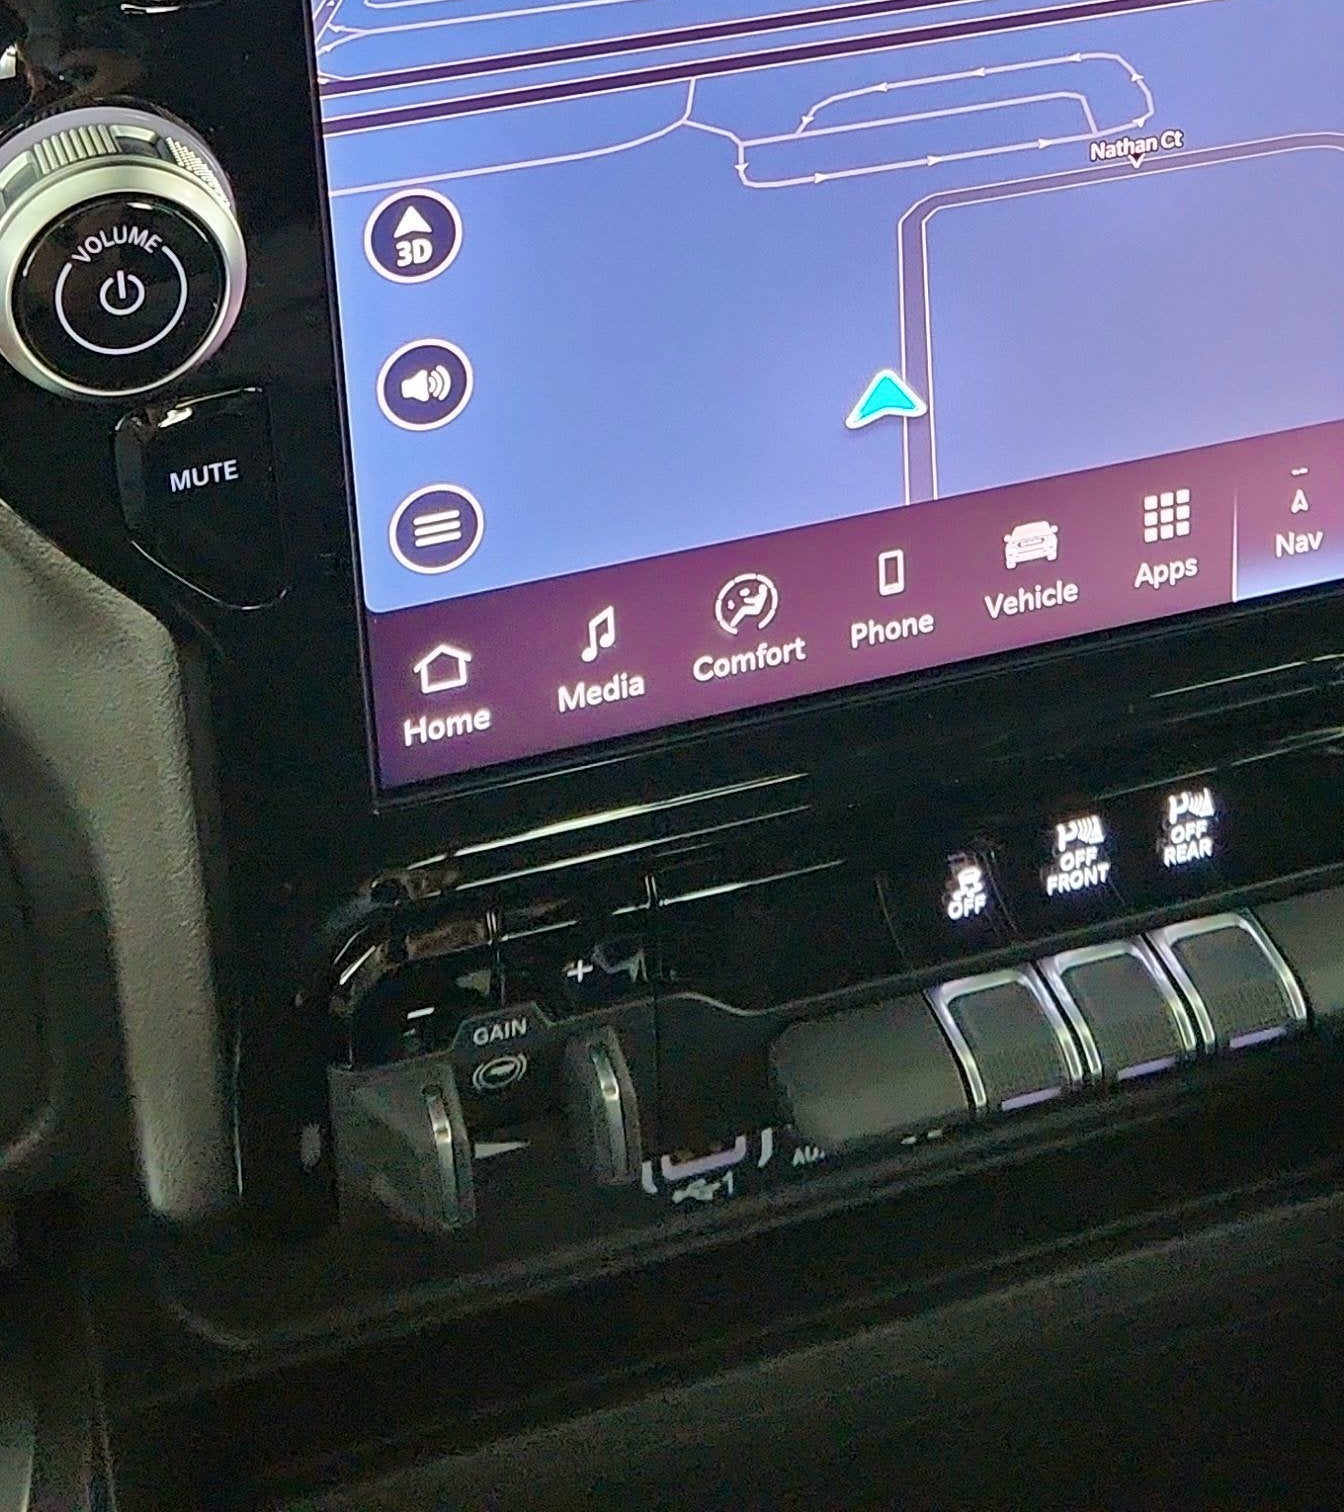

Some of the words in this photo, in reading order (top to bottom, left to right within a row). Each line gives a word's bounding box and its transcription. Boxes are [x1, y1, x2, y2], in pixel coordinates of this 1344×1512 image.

[1090, 136, 1158, 161] Nathan
[1160, 130, 1183, 150] Ct
[71, 226, 163, 265] VOLUME
[396, 238, 433, 267] 3D
[170, 460, 239, 492] MUTE
[1275, 531, 1323, 558] Nav
[1135, 557, 1198, 589] Apps
[984, 580, 1079, 619] Vehicle
[850, 613, 935, 649] Phone
[693, 637, 807, 682] Comfort
[557, 673, 645, 713] Media
[403, 708, 491, 747] Home
[1170, 820, 1209, 845] OFF
[1060, 847, 1099, 872] OFF
[1164, 838, 1214, 868] REAR
[1047, 862, 1111, 897] FRONT
[947, 897, 986, 921] OFF
[473, 1018, 528, 1046] GAIN
